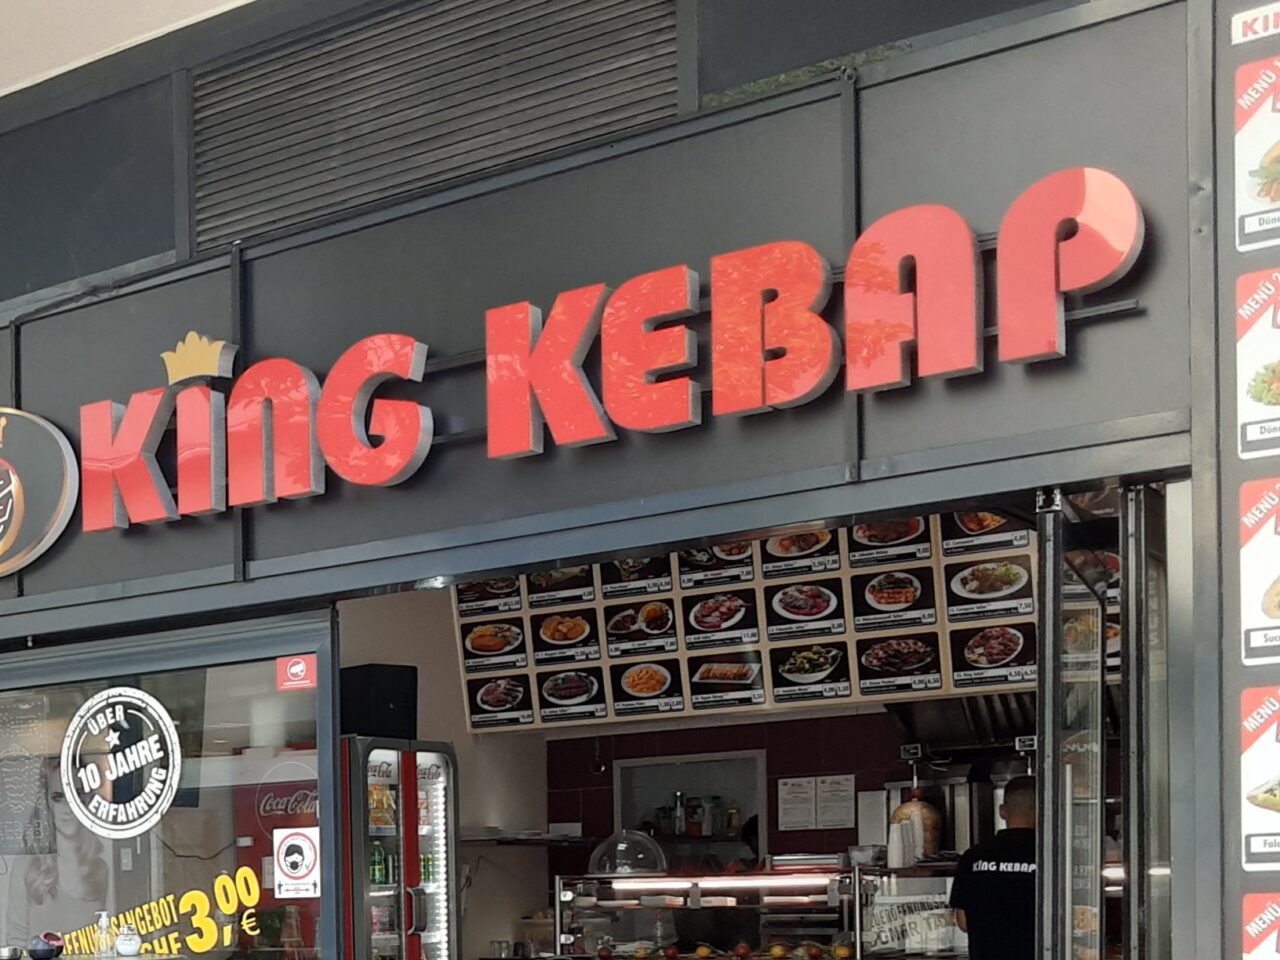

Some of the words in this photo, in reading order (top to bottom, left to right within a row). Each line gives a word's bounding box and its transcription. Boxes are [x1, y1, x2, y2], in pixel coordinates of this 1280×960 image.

[1238, 68, 1277, 110] MENÜ
[1239, 280, 1275, 319] MENÜ
[80, 333, 434, 532] KING
[485, 167, 1145, 460] KEBAP
[1242, 490, 1279, 528] MENÜ
[87, 705, 124, 735] ÜBER
[1243, 697, 1279, 732] MENÜ
[77, 763, 101, 793] 10
[105, 734, 164, 781] JAHRE
[88, 767, 167, 822] ERFAHRUNG
[999, 862, 1037, 873] KEBAP
[1245, 902, 1280, 938] MENÜ
